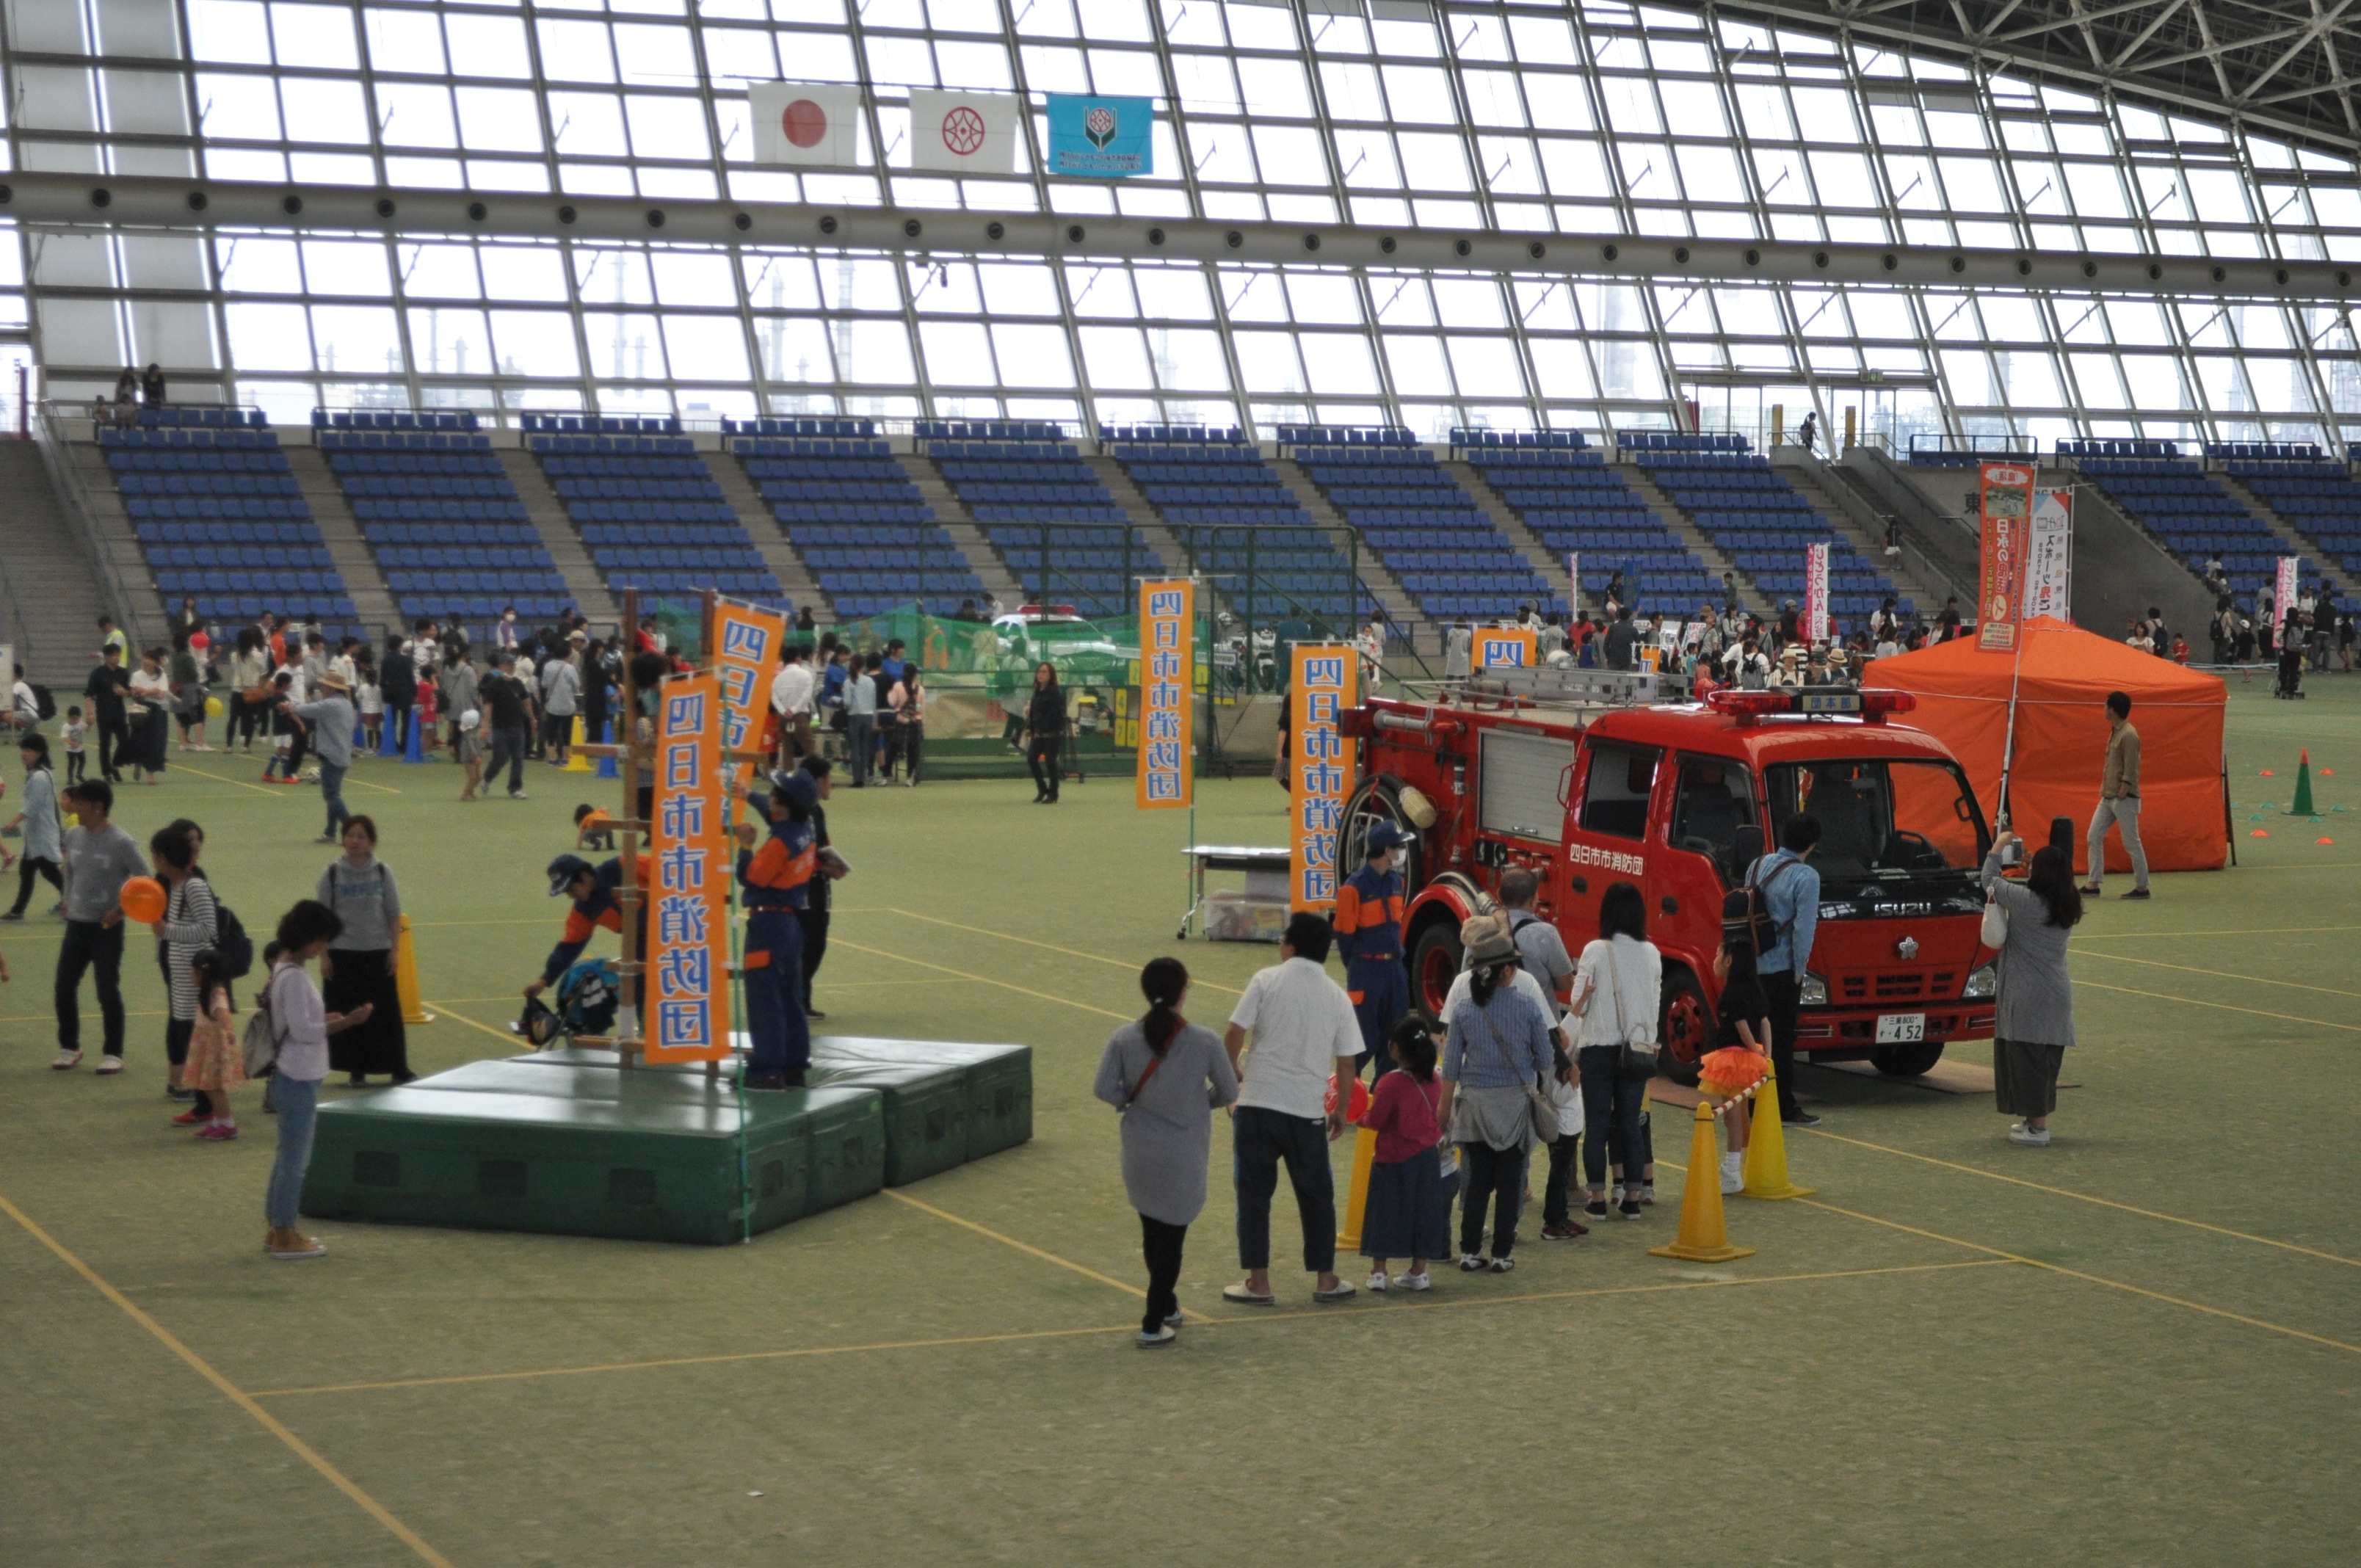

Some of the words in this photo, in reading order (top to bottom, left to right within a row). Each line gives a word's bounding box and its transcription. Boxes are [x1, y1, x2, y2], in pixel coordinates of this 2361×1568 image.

[1965, 493, 1980, 514] 東
[1811, 697, 1851, 709] 団本部
[1570, 843, 1644, 876] 四日市市消防団
[1874, 902, 1932, 915] ISUZU
